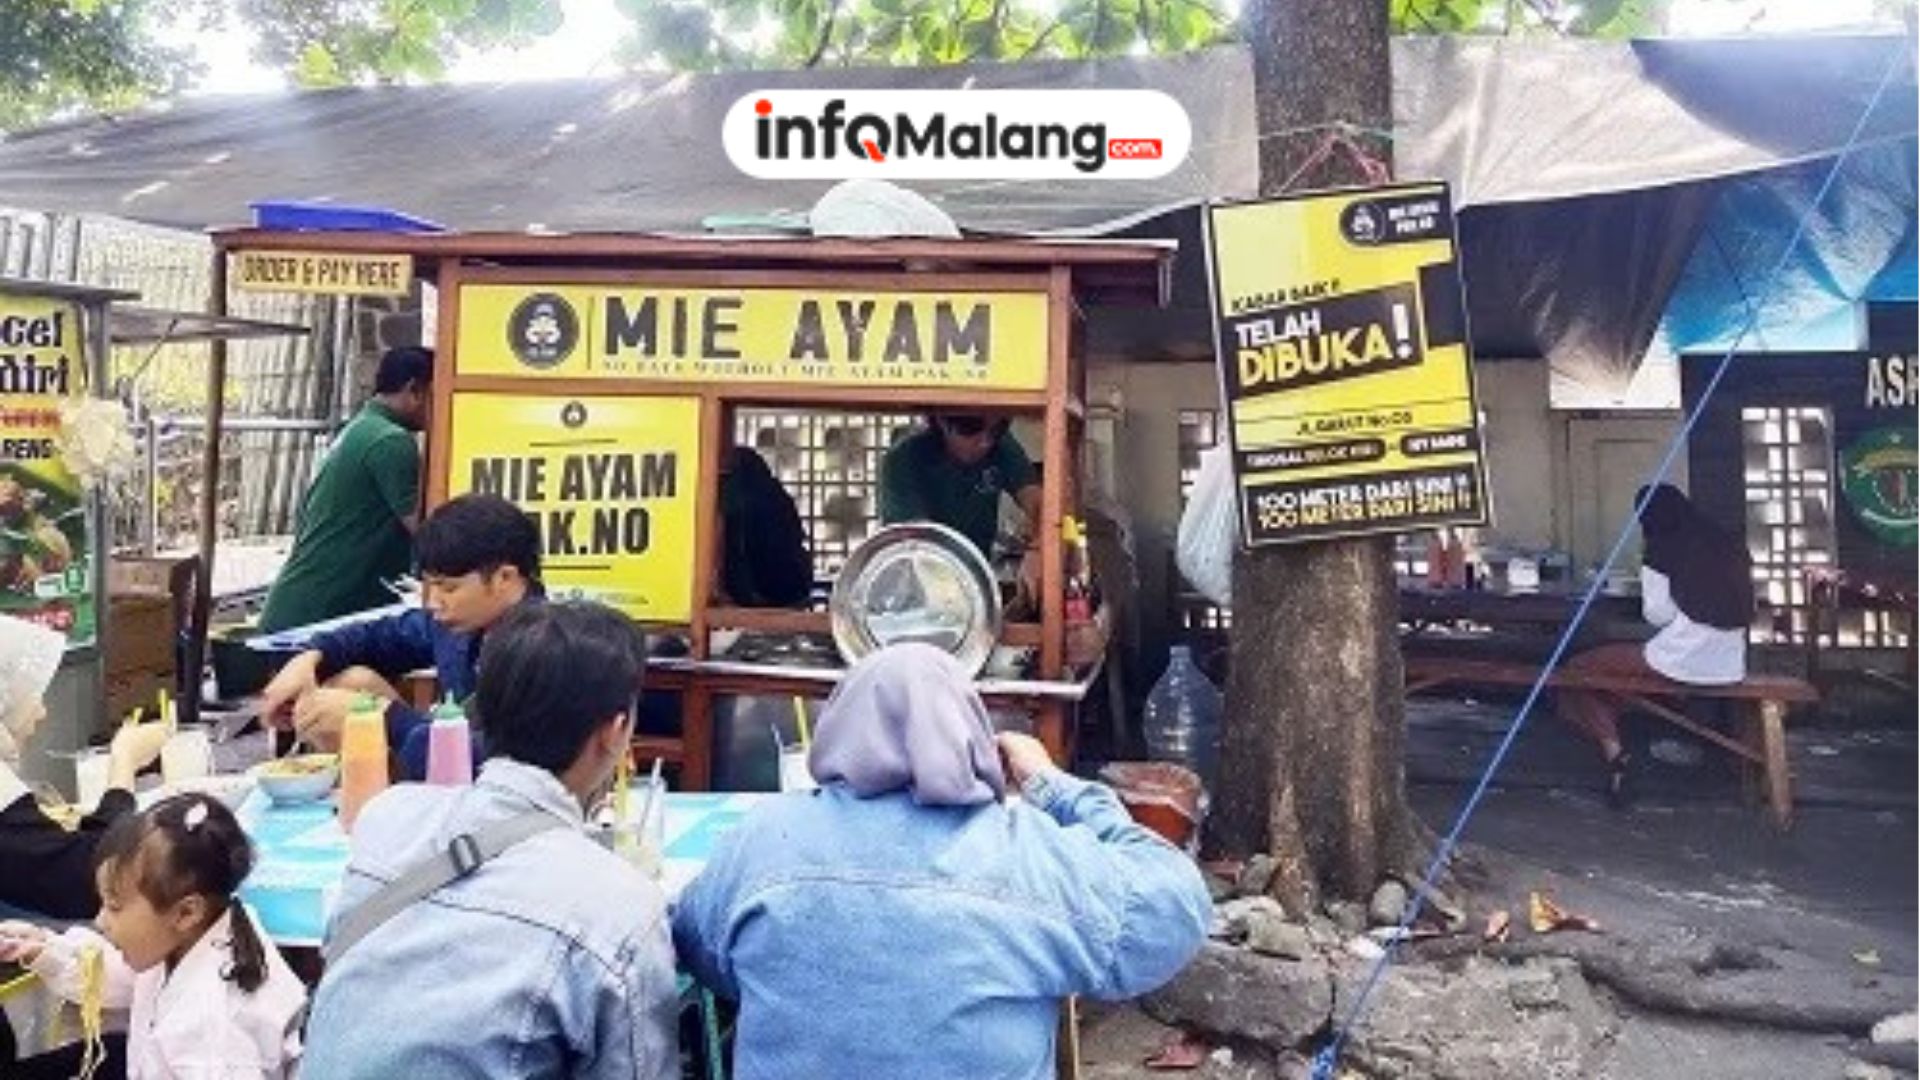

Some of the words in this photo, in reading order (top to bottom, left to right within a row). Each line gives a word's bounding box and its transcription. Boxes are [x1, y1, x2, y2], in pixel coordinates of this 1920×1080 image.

[318, 257, 352, 287] PAY
[356, 260, 401, 289] HERE
[0, 312, 63, 348] cel
[605, 296, 743, 360] MIE
[790, 298, 992, 365] AYAM
[1234, 307, 1322, 349] TELAH
[471, 457, 547, 501] MIE
[559, 453, 677, 501] AYAM
[1300, 485, 1363, 506] METER
[1365, 479, 1412, 501] DARI
[1257, 509, 1298, 530] 100
[1300, 501, 1364, 526] METER
[1367, 498, 1413, 518] DARI
